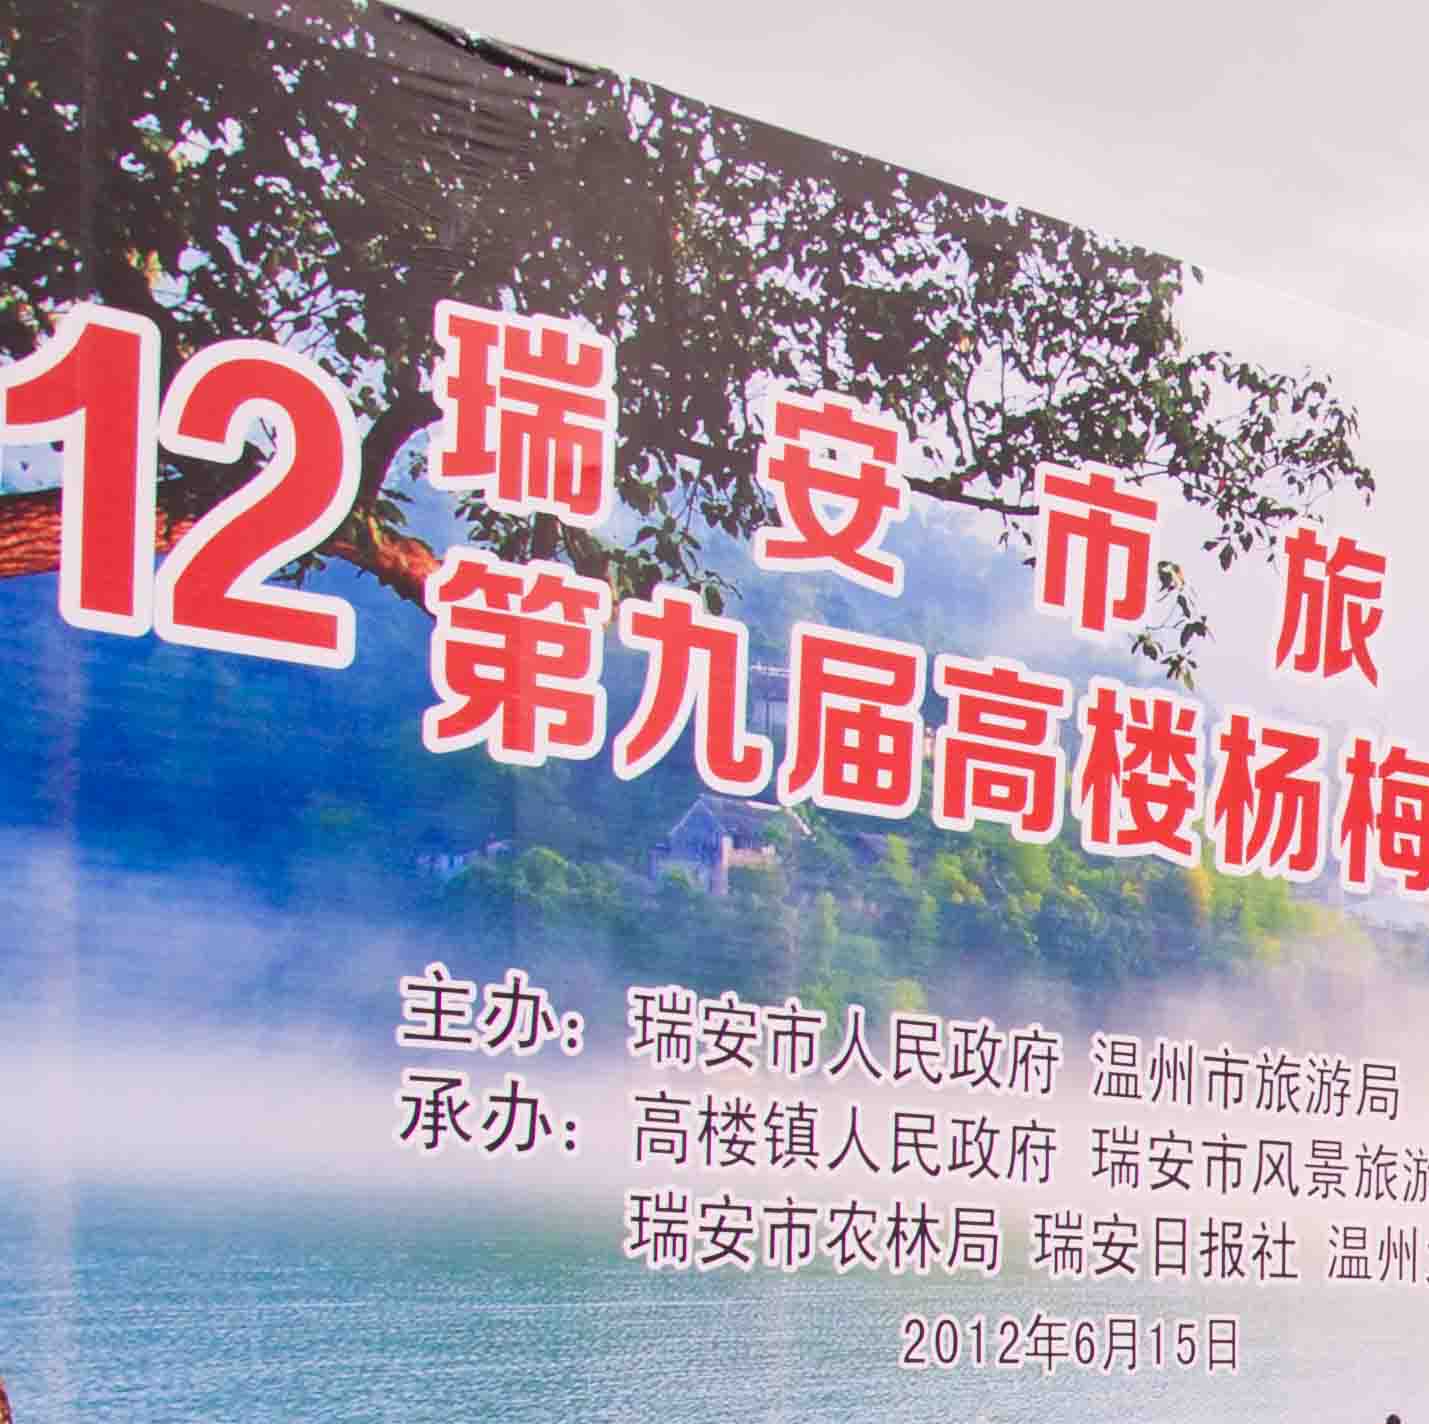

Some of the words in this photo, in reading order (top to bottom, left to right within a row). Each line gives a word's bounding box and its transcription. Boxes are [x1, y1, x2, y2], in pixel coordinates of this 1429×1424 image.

[3, 318, 342, 655] 12
[632, 990, 1060, 1093] 瑞安市人民政府
[1091, 1034, 1401, 1120] 温州市旅游局
[633, 1090, 1057, 1184] 高楼镇人民政府
[628, 1193, 1001, 1272] 瑞安市农林局
[1033, 1213, 1299, 1281] 瑞安日报社
[902, 1313, 1239, 1372] 2012年6月15日
